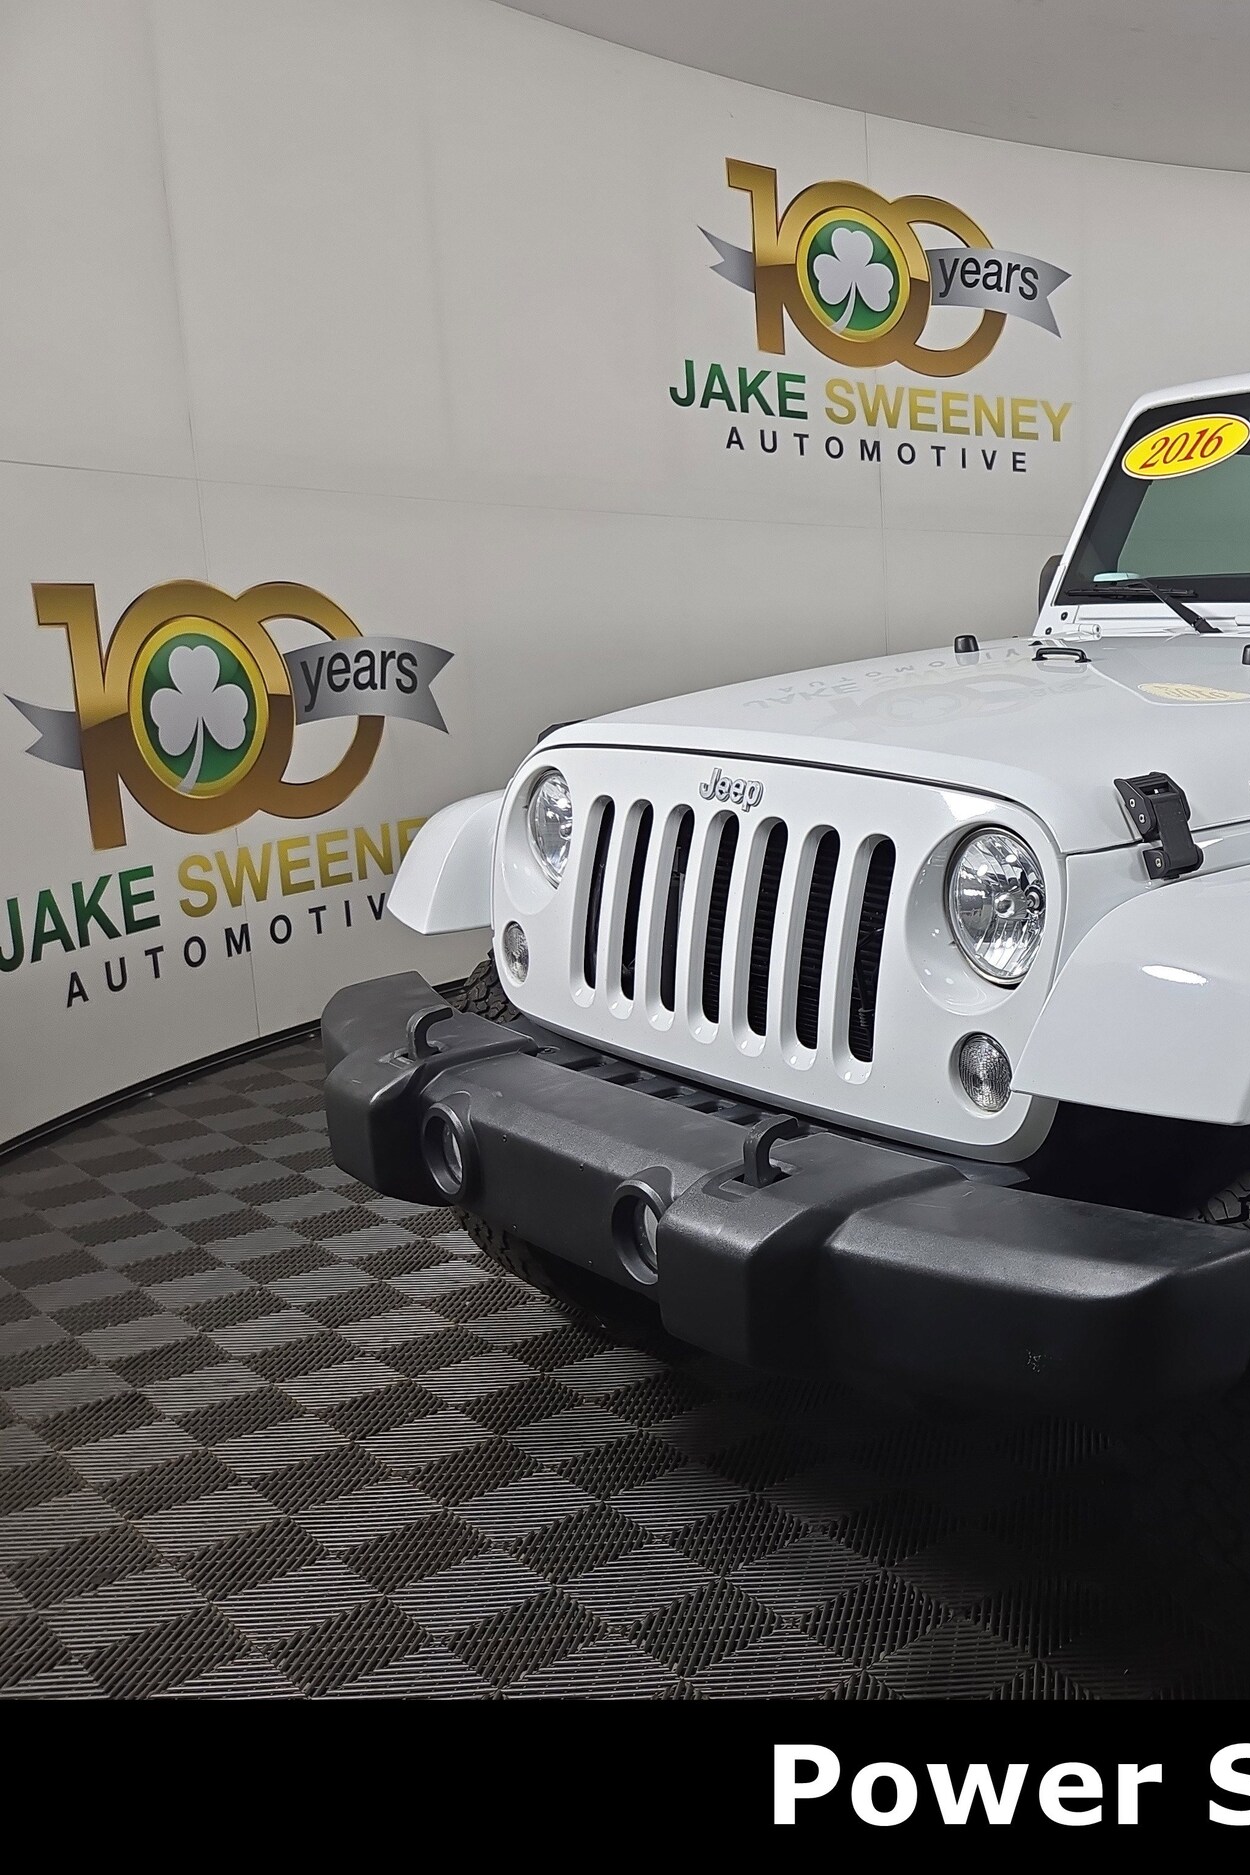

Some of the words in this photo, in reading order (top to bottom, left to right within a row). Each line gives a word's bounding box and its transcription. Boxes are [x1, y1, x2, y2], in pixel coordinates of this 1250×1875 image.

[725, 157, 1007, 378] 100
[938, 256, 1040, 301] years
[669, 359, 808, 420] JAKE
[824, 378, 1073, 442] SWEENEY
[726, 426, 1027, 472] AUTOMOTIVE
[1138, 422, 1234, 470] 2016
[31, 579, 385, 852] 100
[300, 648, 419, 713] years
[699, 767, 764, 812] Jeep
[0, 865, 161, 973] JAKE
